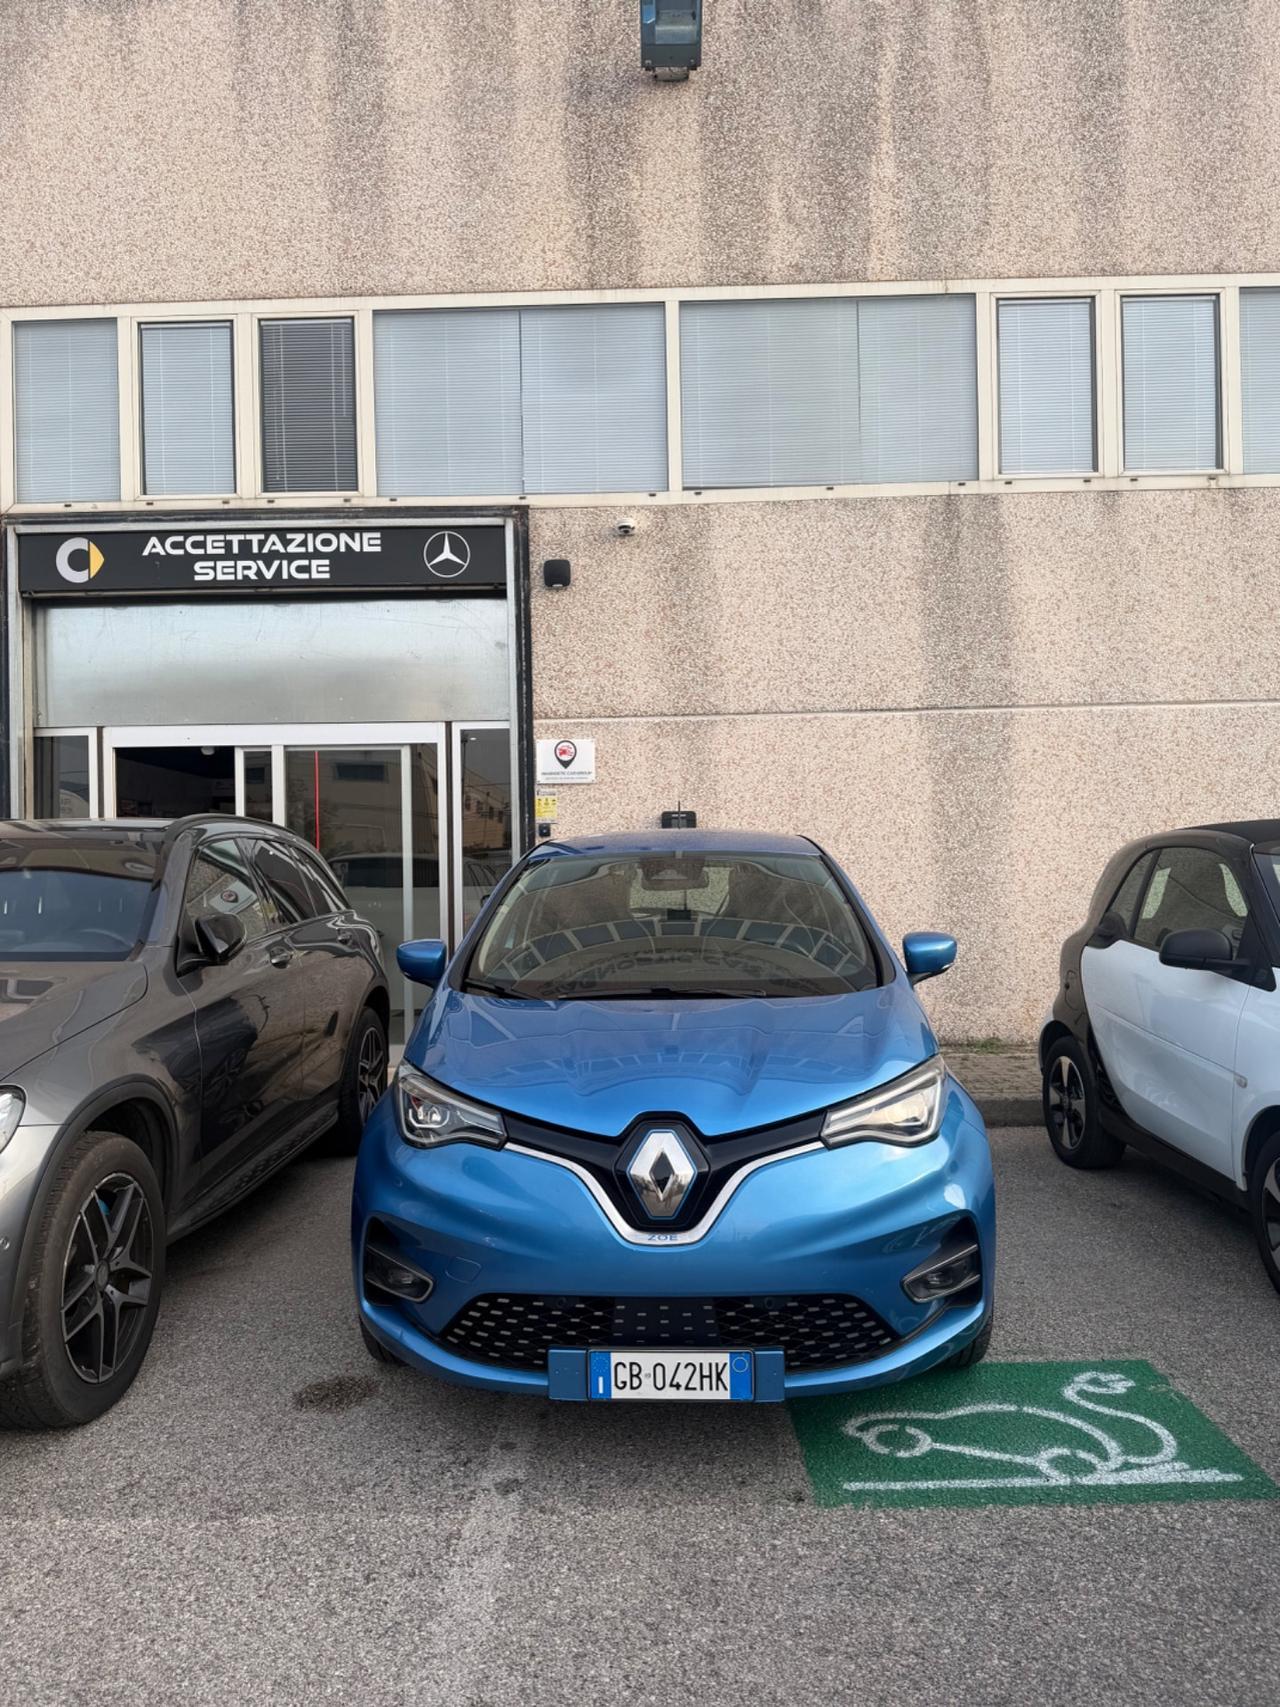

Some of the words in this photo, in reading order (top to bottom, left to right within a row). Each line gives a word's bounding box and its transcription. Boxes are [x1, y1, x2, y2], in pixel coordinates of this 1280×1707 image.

[142, 532, 382, 556] ACCETTAZIONE
[193, 559, 331, 581] SERVICE
[648, 1233, 679, 1241] ZOE
